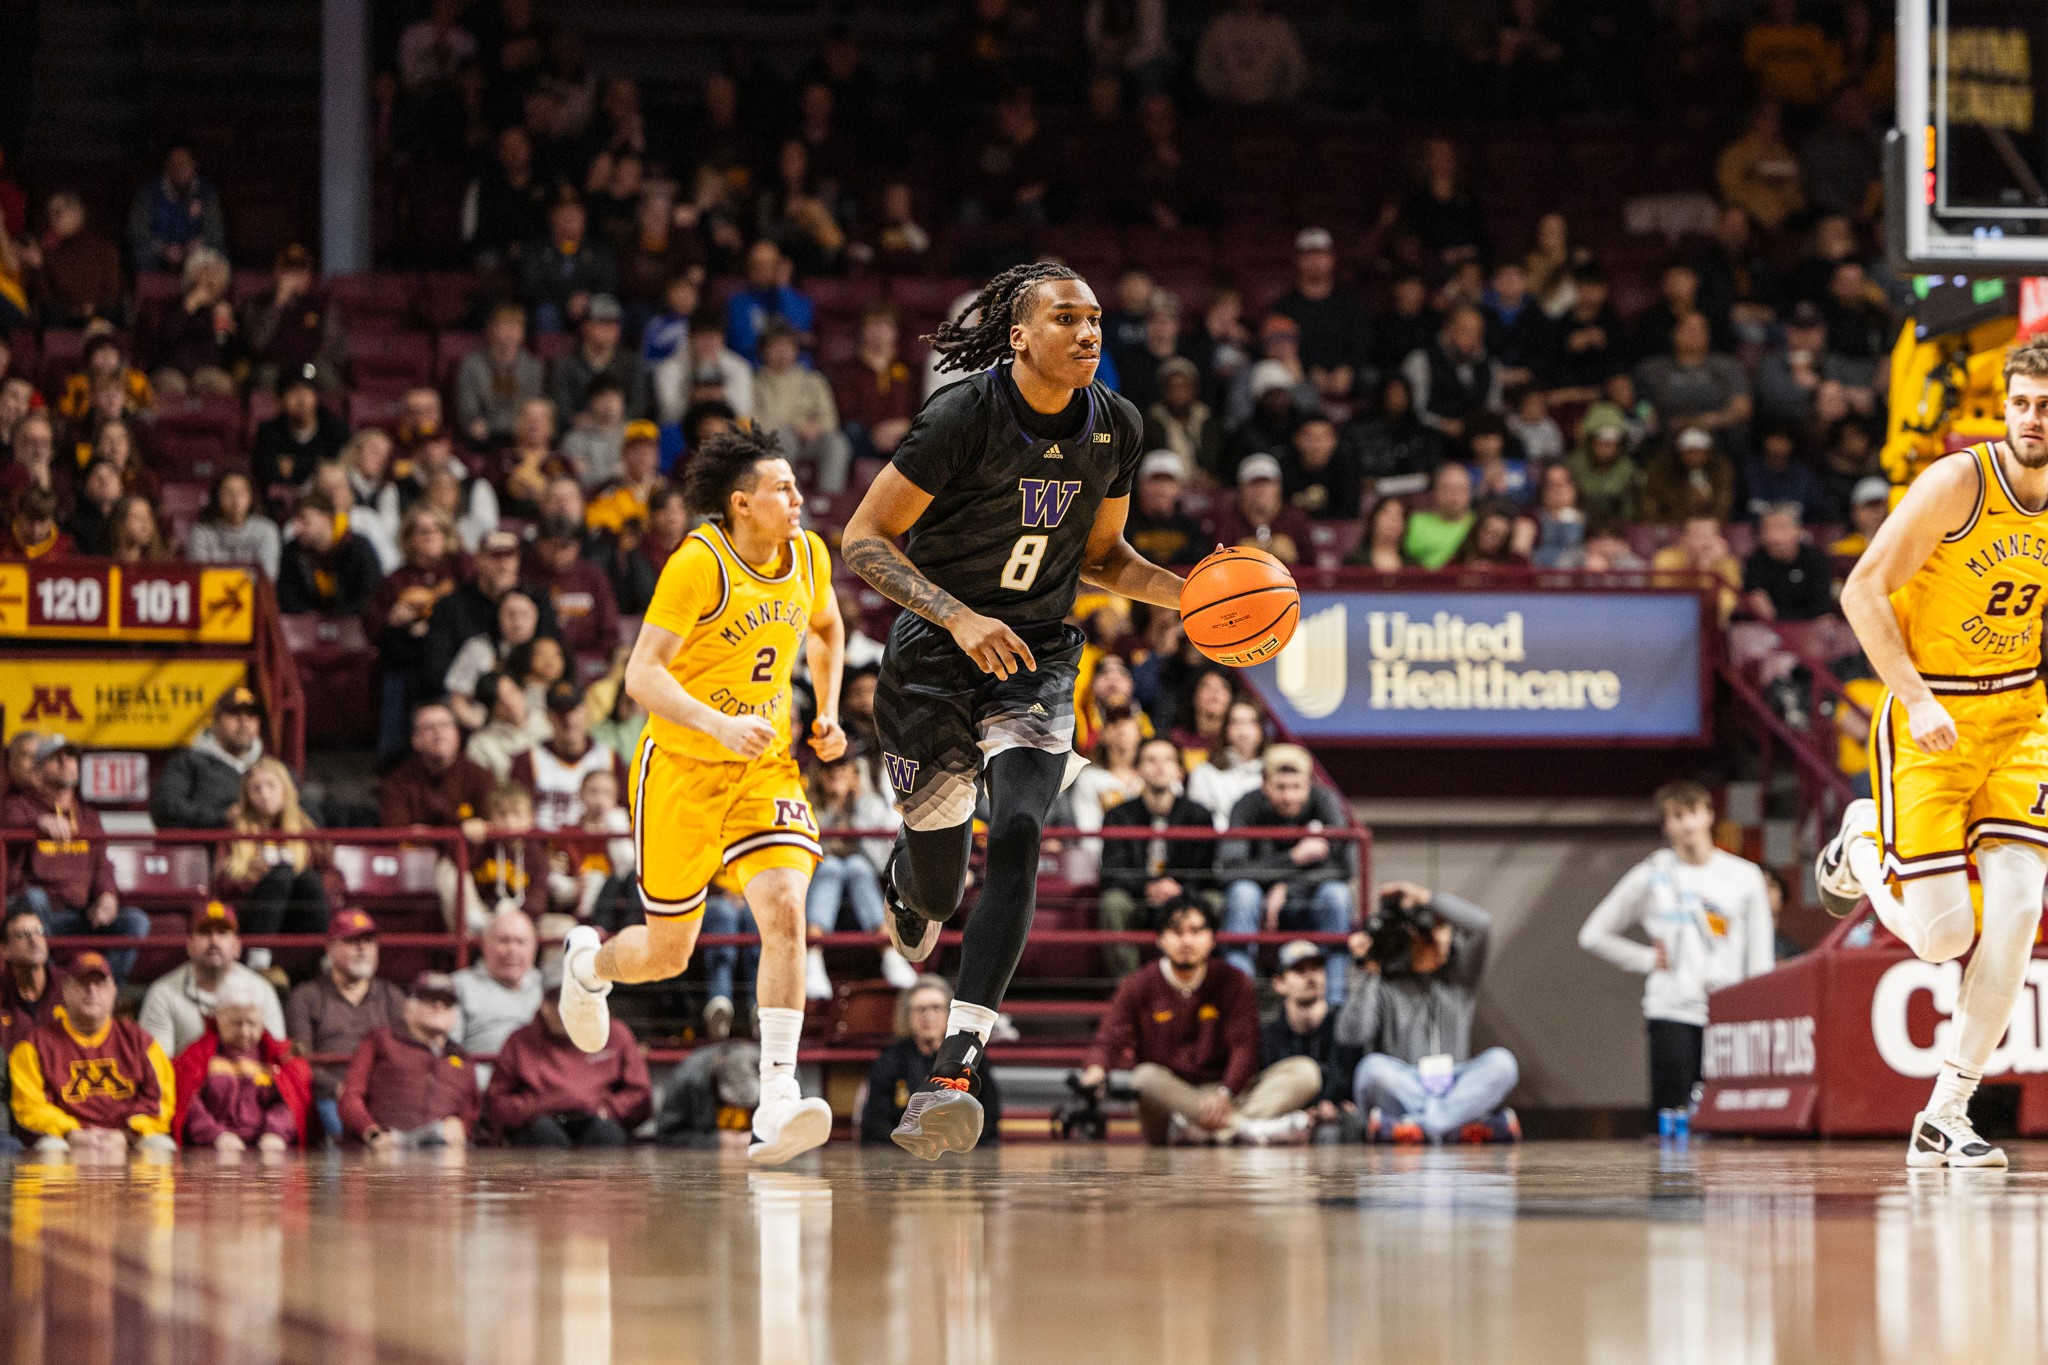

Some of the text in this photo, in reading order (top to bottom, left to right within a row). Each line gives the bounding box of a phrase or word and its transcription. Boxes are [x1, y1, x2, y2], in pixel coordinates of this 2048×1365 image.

[1019, 478, 1082, 528] W
[1000, 535, 1049, 592] 8
[37, 577, 102, 622] 120
[132, 579, 191, 623] 101
[1985, 581, 2042, 616] 23
[1218, 637, 1281, 665] ELITE
[1367, 610, 1526, 662] United
[751, 647, 777, 683] 2
[1367, 658, 1622, 710] Healthcare
[21, 685, 204, 723] M HEALTH
[884, 752, 920, 794] W
[773, 799, 816, 832] M
[1773, 1015, 1817, 1076] PLUS
[61, 1058, 135, 1102] M
